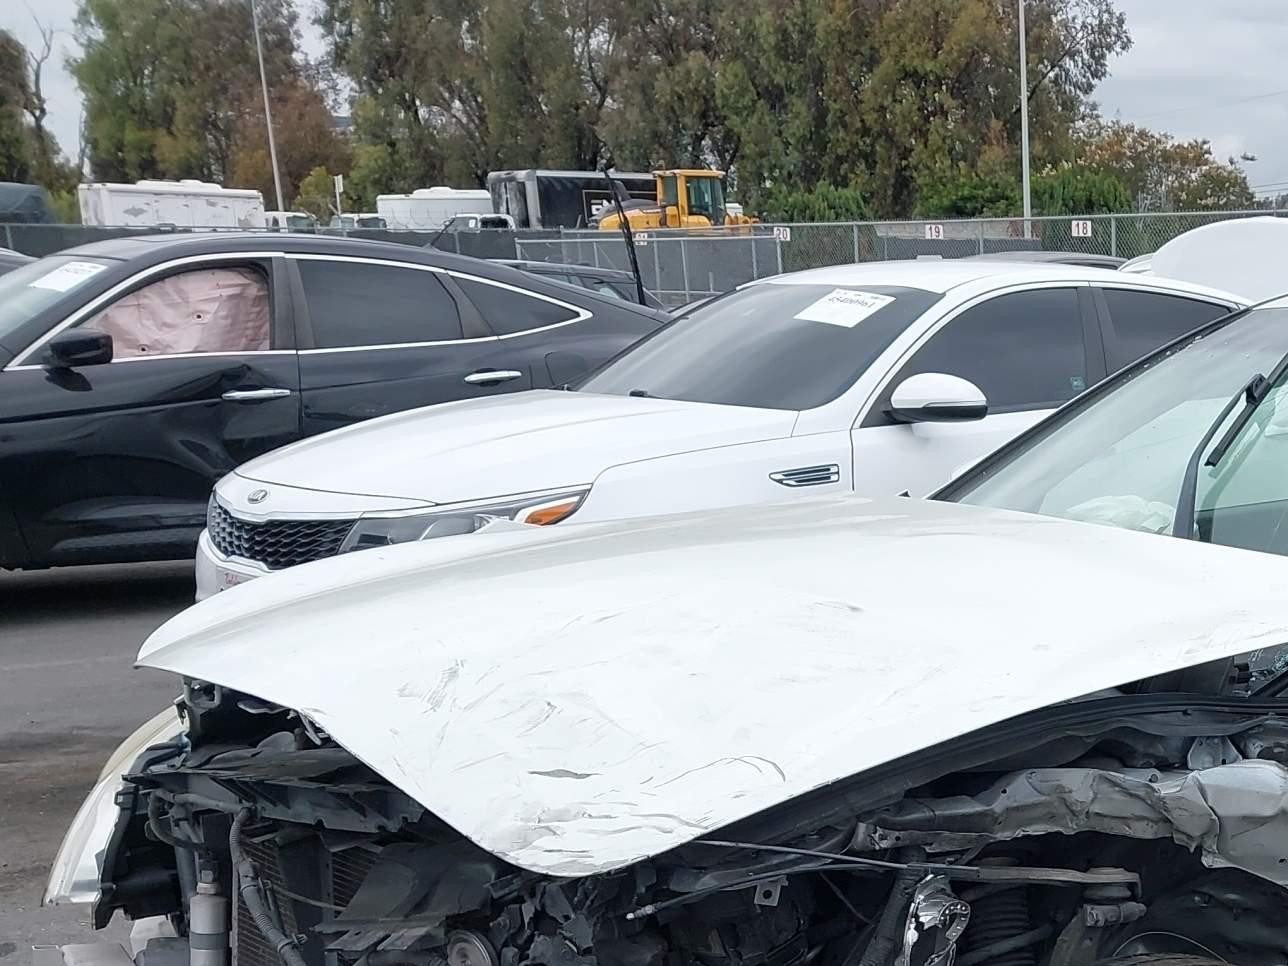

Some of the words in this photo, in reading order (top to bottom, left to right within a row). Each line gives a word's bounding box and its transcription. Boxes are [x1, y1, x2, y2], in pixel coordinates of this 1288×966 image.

[775, 227, 788, 240] 20
[928, 226, 941, 238] 19
[1074, 222, 1088, 236] 18
